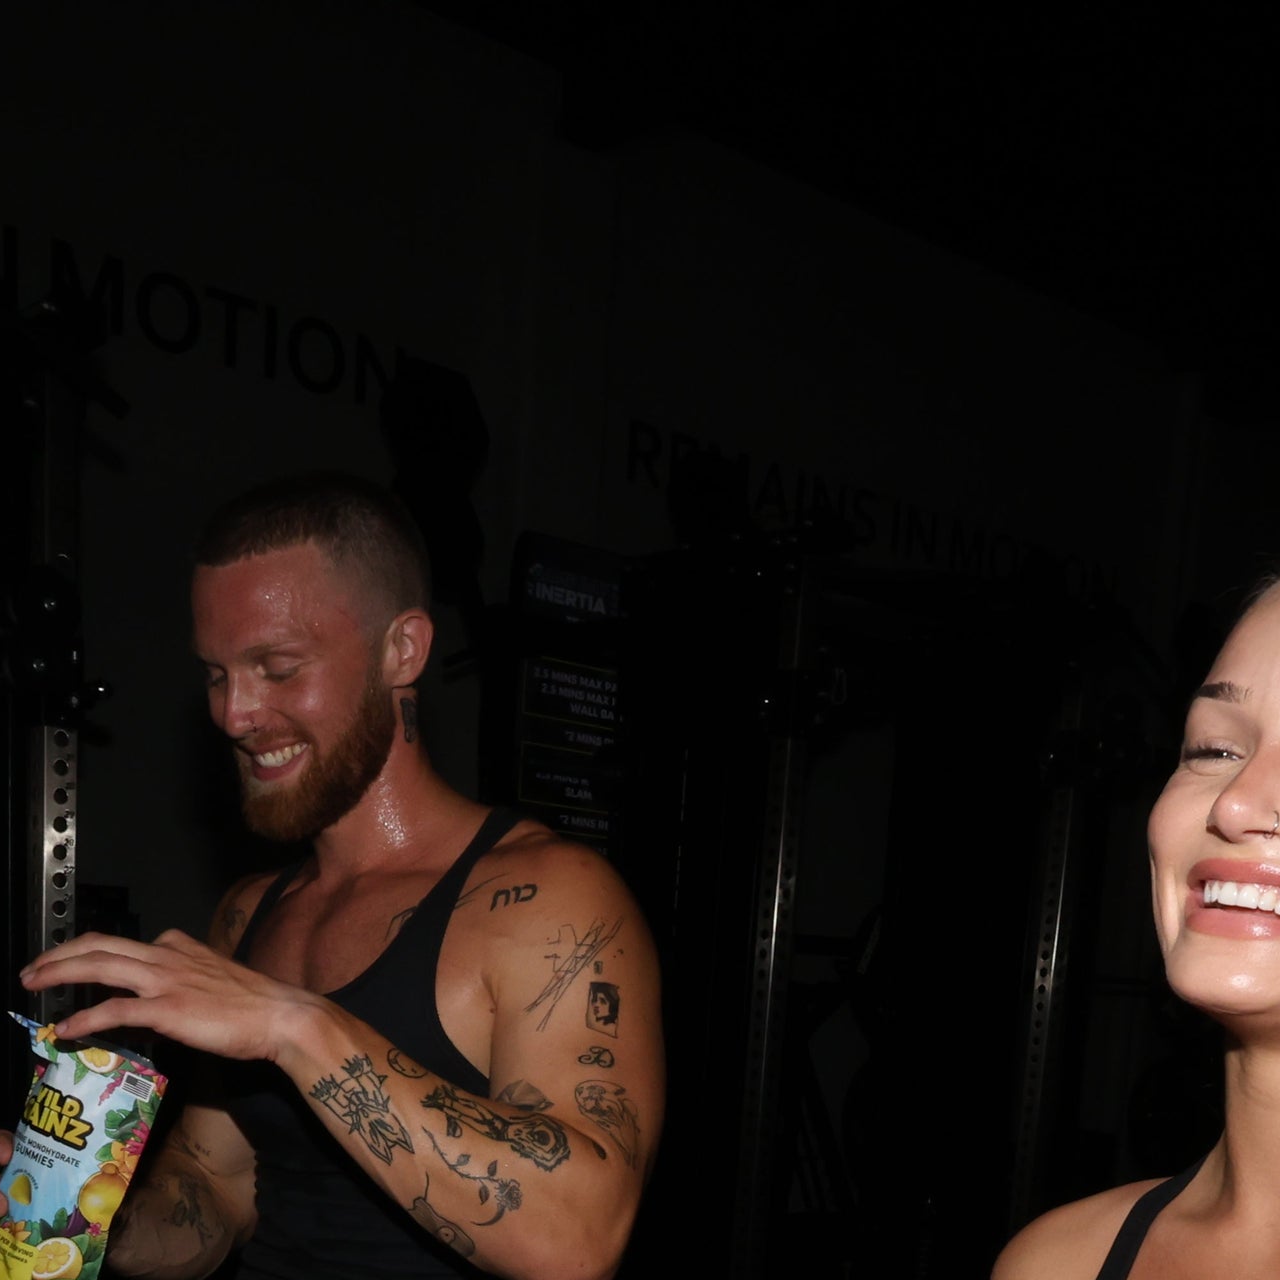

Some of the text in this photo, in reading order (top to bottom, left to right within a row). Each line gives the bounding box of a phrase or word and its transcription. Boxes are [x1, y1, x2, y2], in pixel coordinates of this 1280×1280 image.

[50, 235, 410, 404] MOTION
[627, 419, 1120, 600] RAINS IN MOON
[535, 582, 607, 615] INERTIA
[551, 670, 577, 686] MINS
[579, 675, 603, 690] MAX
[558, 686, 585, 701] MINS
[569, 703, 598, 719] WALL
[15, 1142, 55, 1169] GUMMIES
[27, 1138, 81, 1168] MONOHYDRATE
